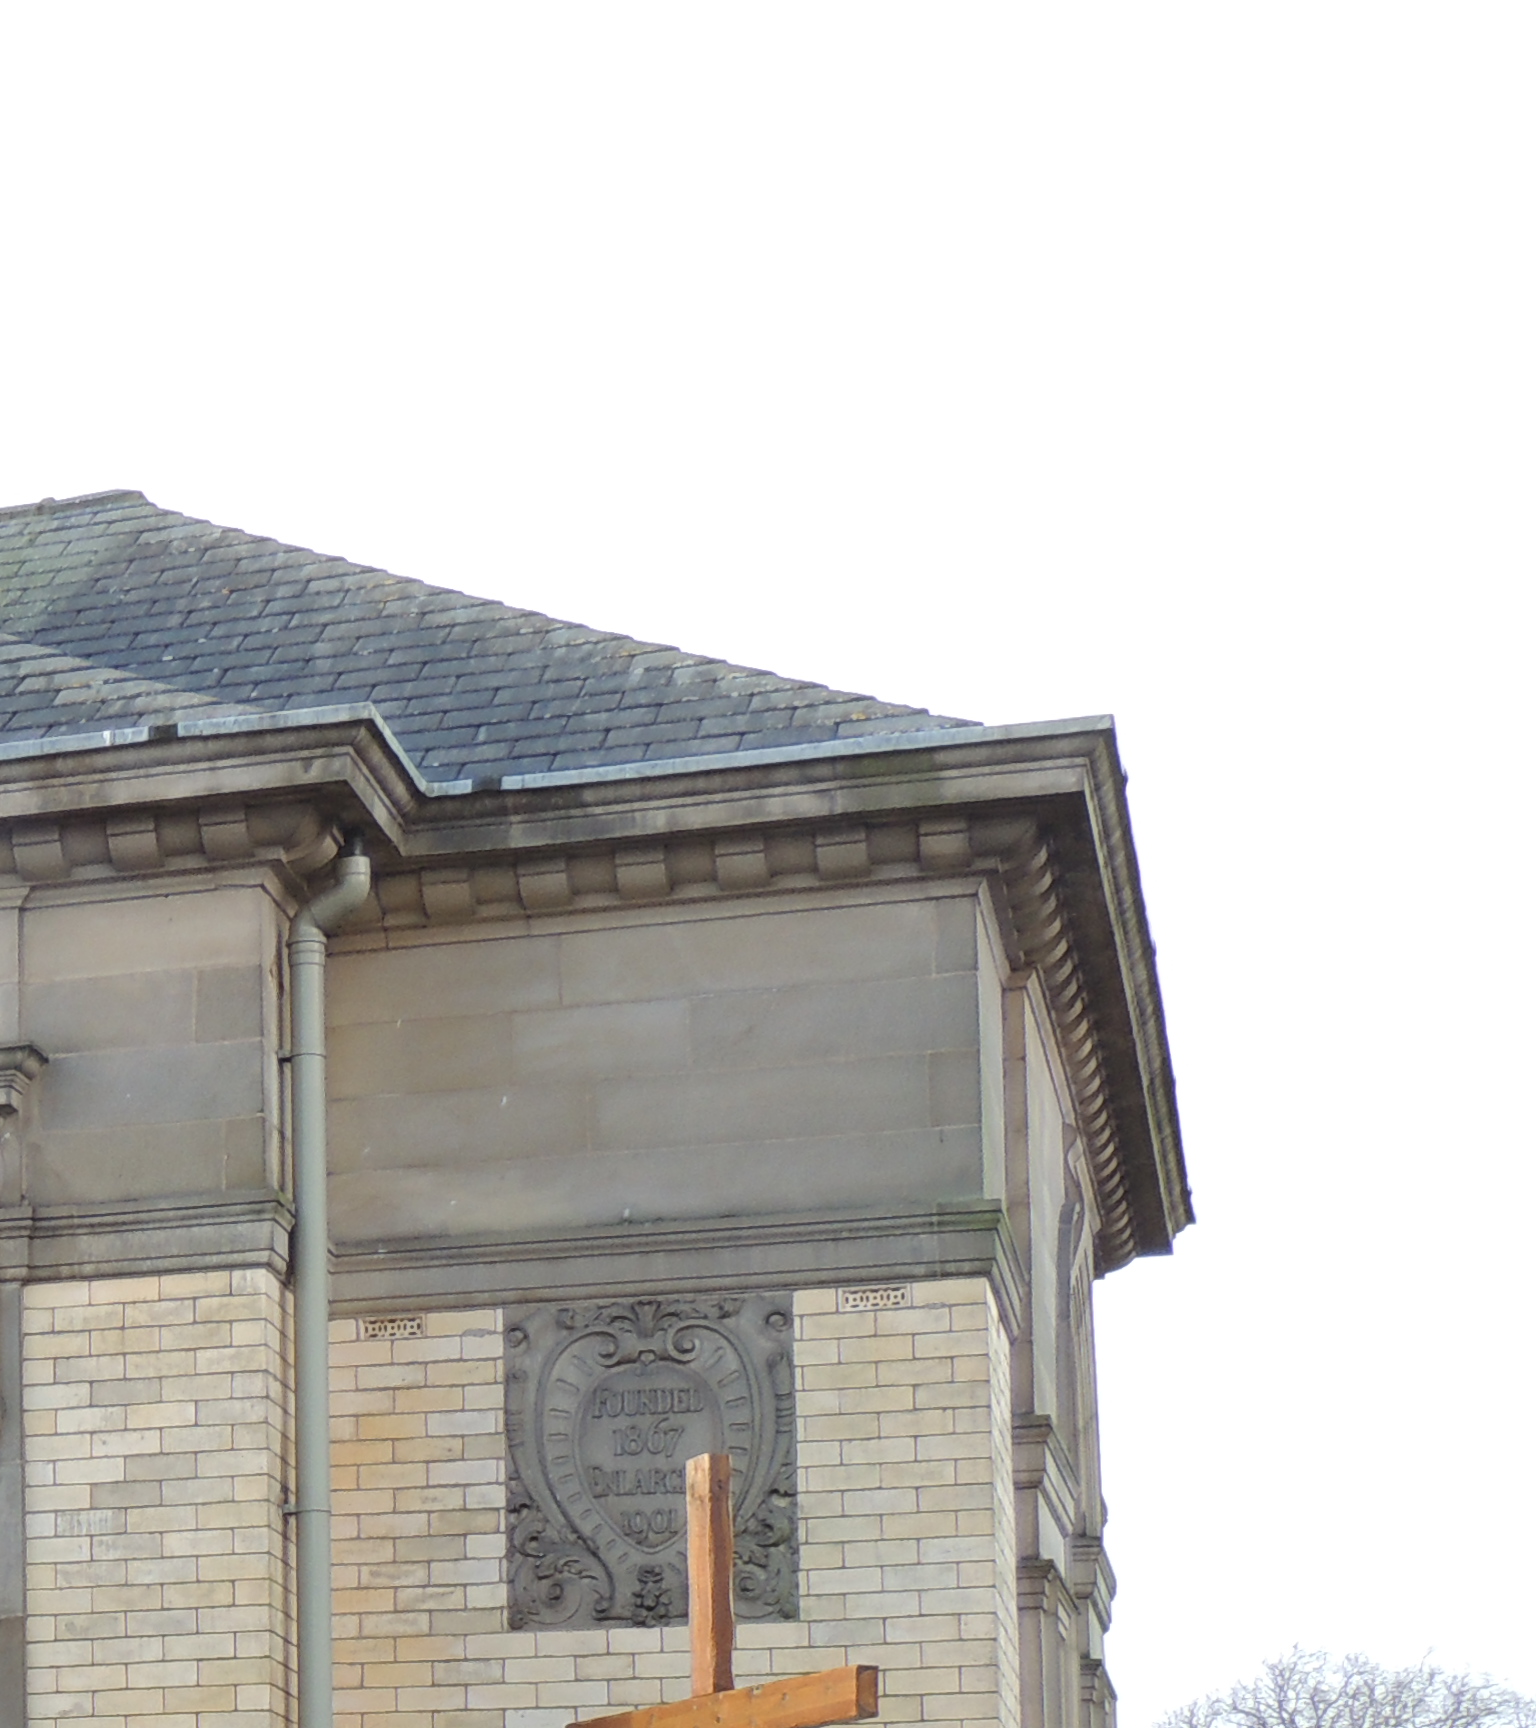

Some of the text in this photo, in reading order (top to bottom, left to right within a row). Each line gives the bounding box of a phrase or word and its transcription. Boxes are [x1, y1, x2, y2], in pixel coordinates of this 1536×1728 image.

[592, 1388, 705, 1419] FOUNDED
[612, 1418, 685, 1458] 1867
[589, 1466, 686, 1498] ENLARG
[620, 1508, 680, 1545] 1901
